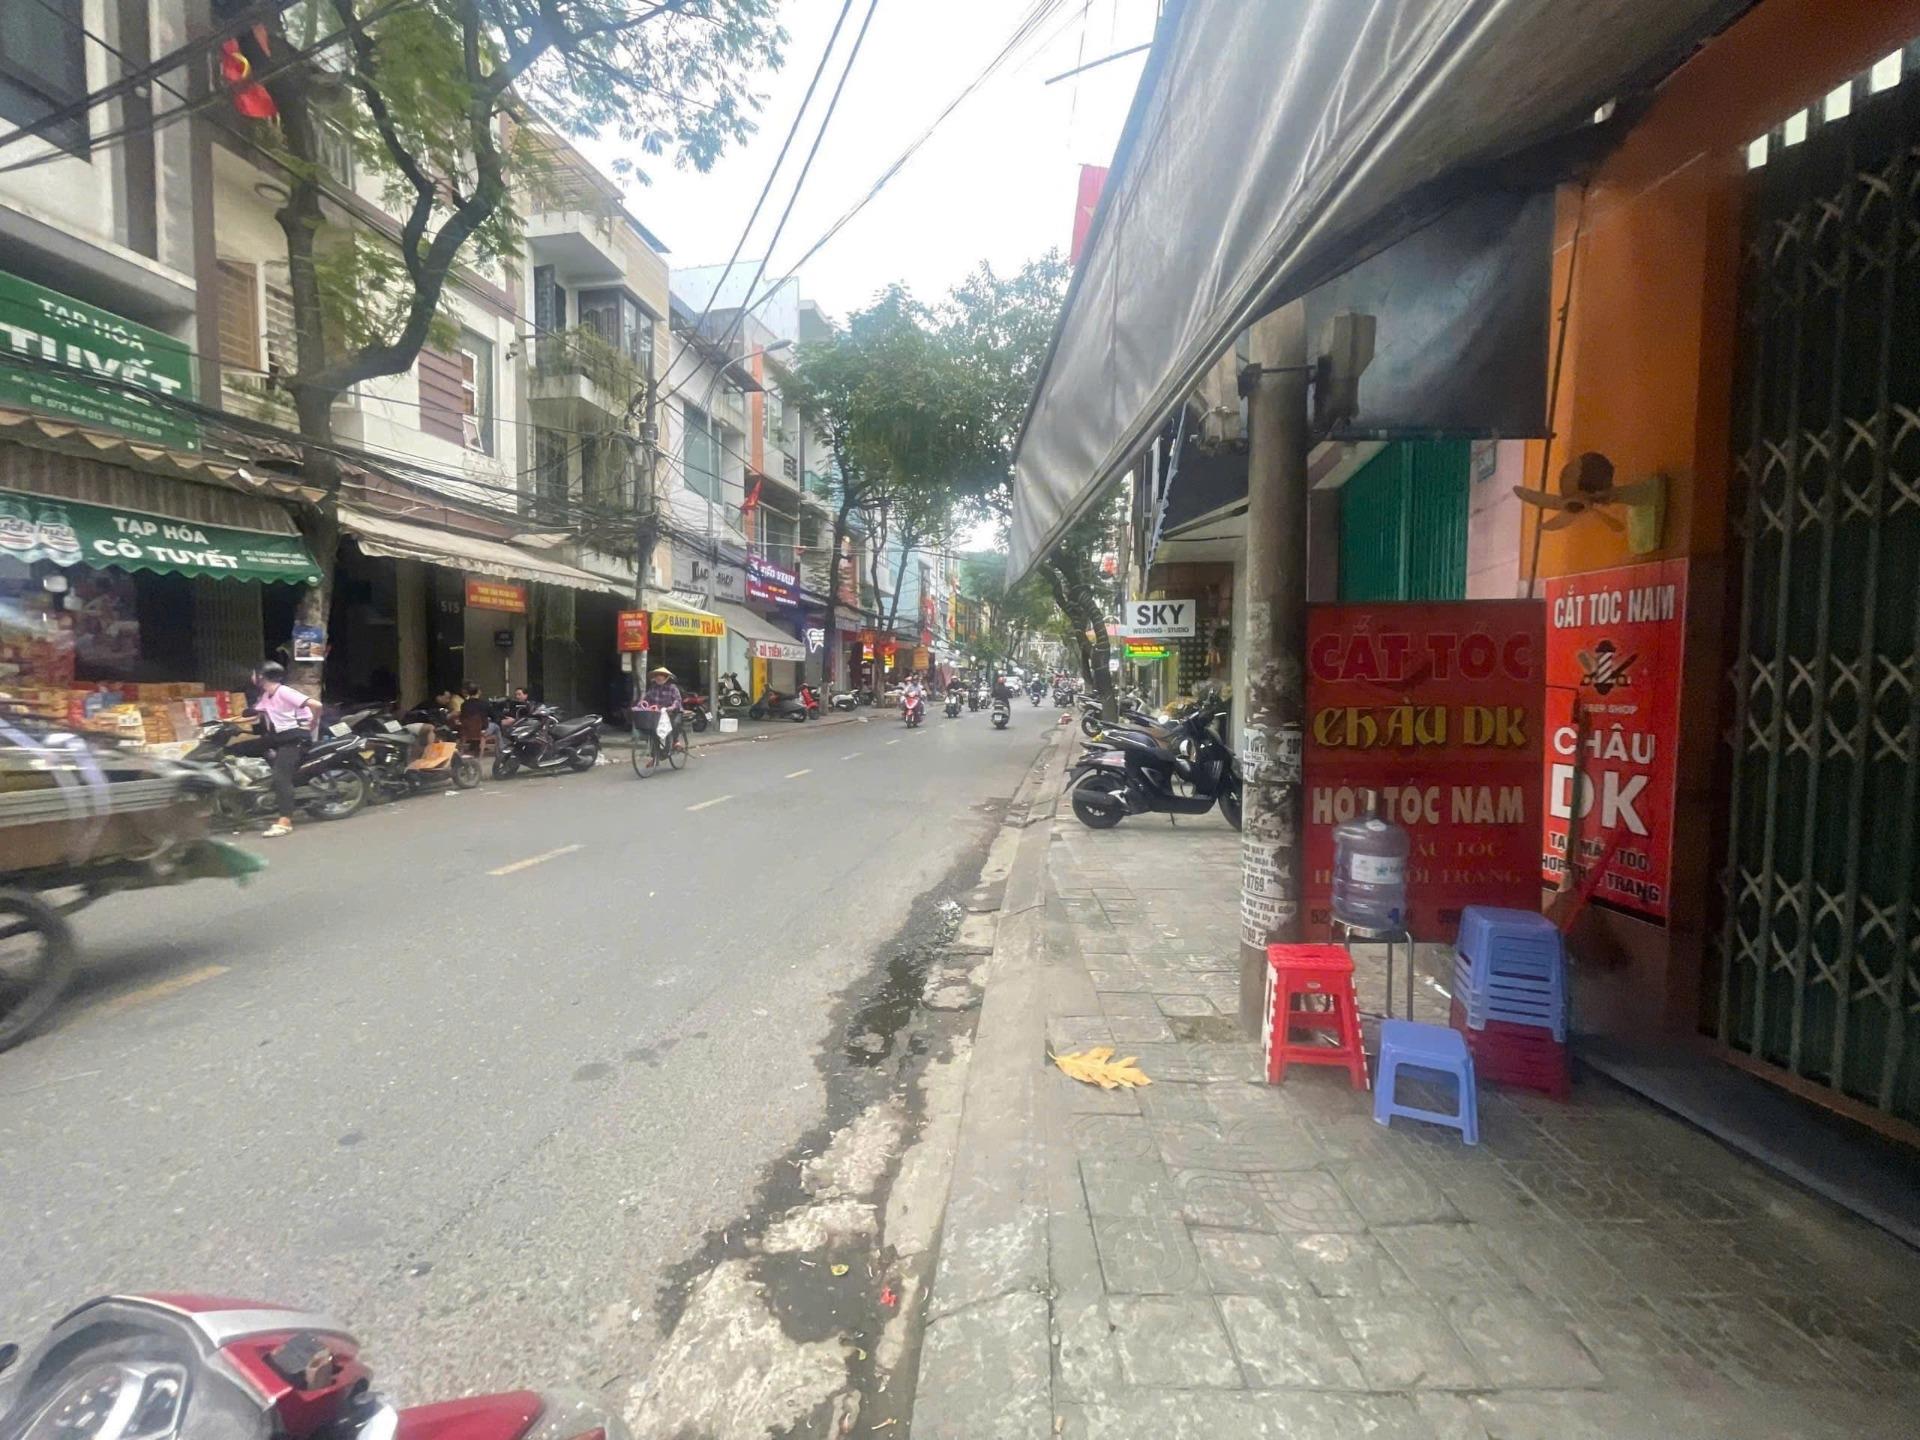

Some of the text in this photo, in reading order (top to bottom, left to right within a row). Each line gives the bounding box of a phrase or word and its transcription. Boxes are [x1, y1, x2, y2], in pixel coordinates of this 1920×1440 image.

[112, 516, 210, 545] TẠP HÓA
[93, 538, 142, 559] CÔ
[146, 546, 238, 569] TUYẾT
[1136, 604, 1185, 626] SKY
[1554, 584, 1676, 629] CẮT TÓC NAM
[1310, 615, 1534, 682] CẮT TÓC
[1463, 704, 1527, 747] DK
[1553, 722, 1656, 765] CHÂU
[1383, 778, 1441, 825] TÓC
[1451, 785, 1525, 824] NAM
[1550, 763, 1649, 837] DK
[1606, 873, 1661, 903] TRANG
